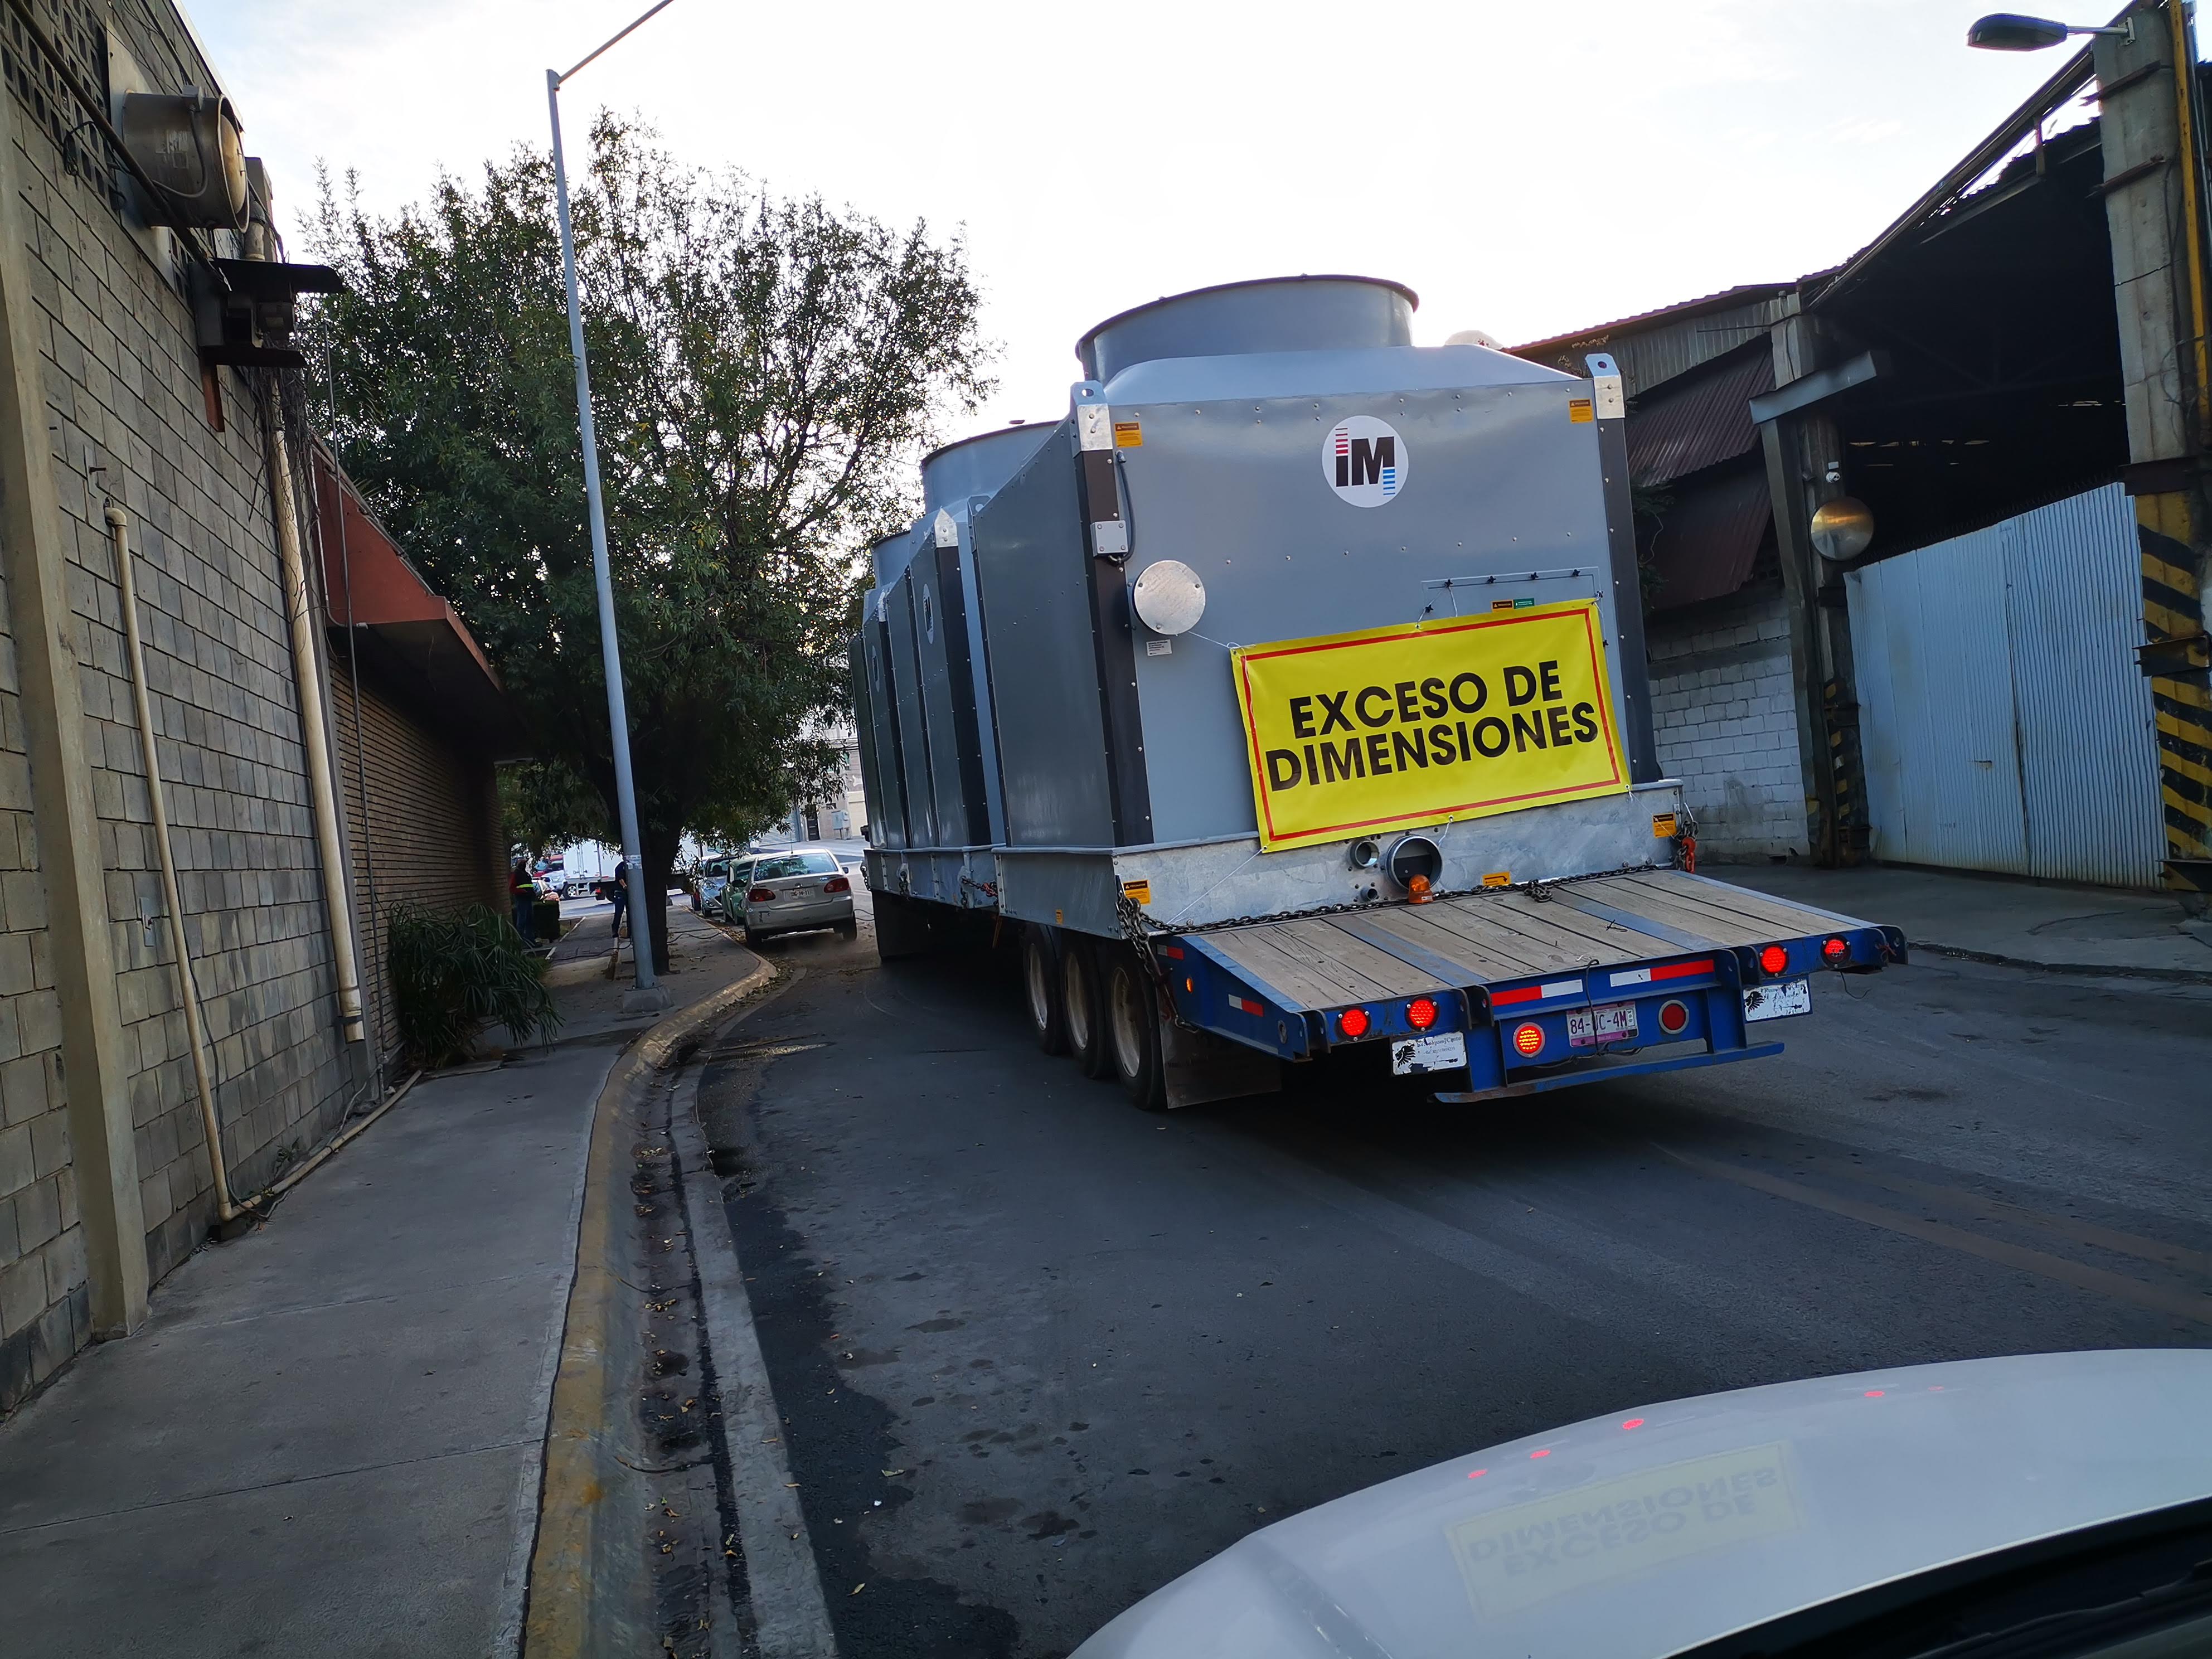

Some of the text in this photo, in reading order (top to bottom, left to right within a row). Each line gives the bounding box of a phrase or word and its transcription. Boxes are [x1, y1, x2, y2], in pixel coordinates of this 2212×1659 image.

[1289, 660, 1563, 739] EXCESO DE
[1264, 701, 1599, 792] DIMENSIONES
